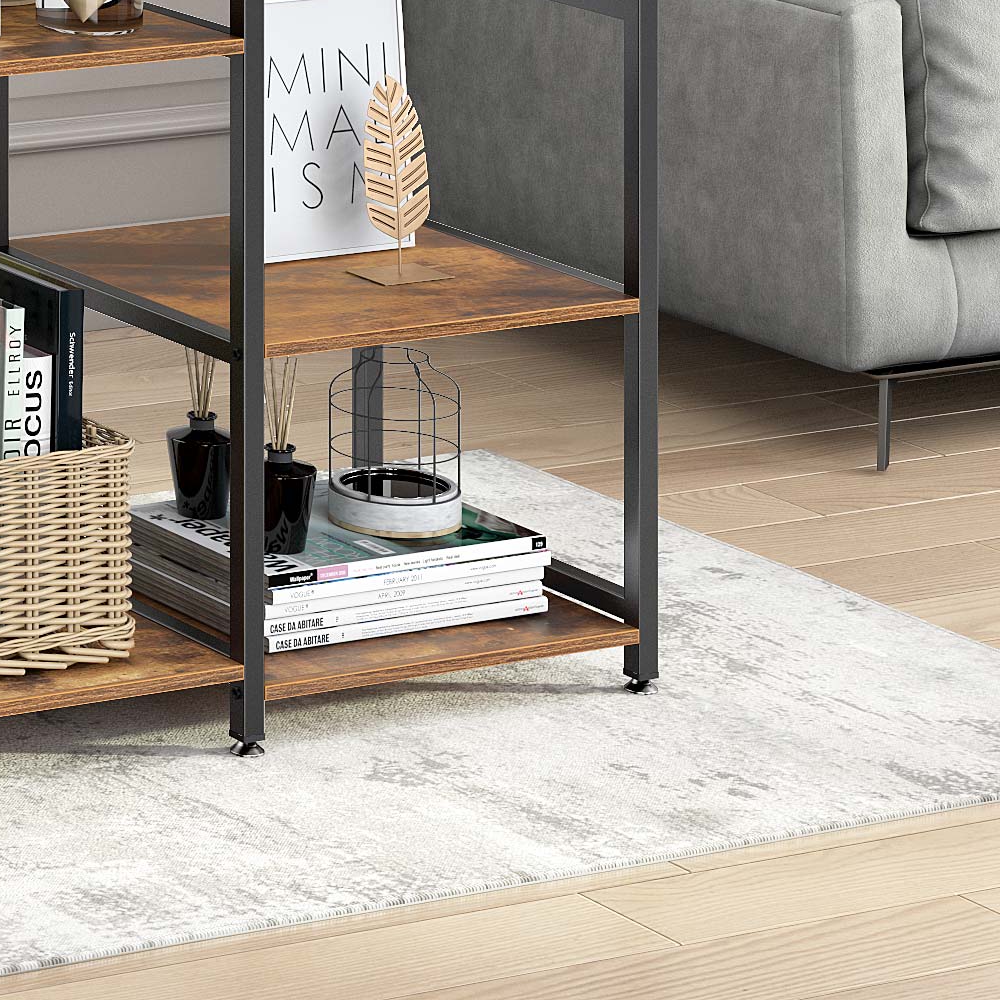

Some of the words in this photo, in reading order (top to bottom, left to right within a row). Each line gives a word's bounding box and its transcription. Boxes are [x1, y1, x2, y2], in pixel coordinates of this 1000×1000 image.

[267, 41, 388, 99] MINI
[7, 325, 22, 397] ELLROY
[68, 331, 76, 379] Schwender
[24, 370, 43, 456] OCUS
[290, 591, 311, 599] VOGUE
[383, 576, 410, 586] FEBRUARY
[411, 574, 423, 582] 2011
[270, 622, 287, 634] CASE
[287, 621, 296, 631] DA
[297, 617, 324, 630] ABITARE
[284, 605, 305, 613] VOGUE
[275, 638, 292, 650] CASE
[293, 637, 302, 647] DA
[303, 633, 330, 646] ABITARE
